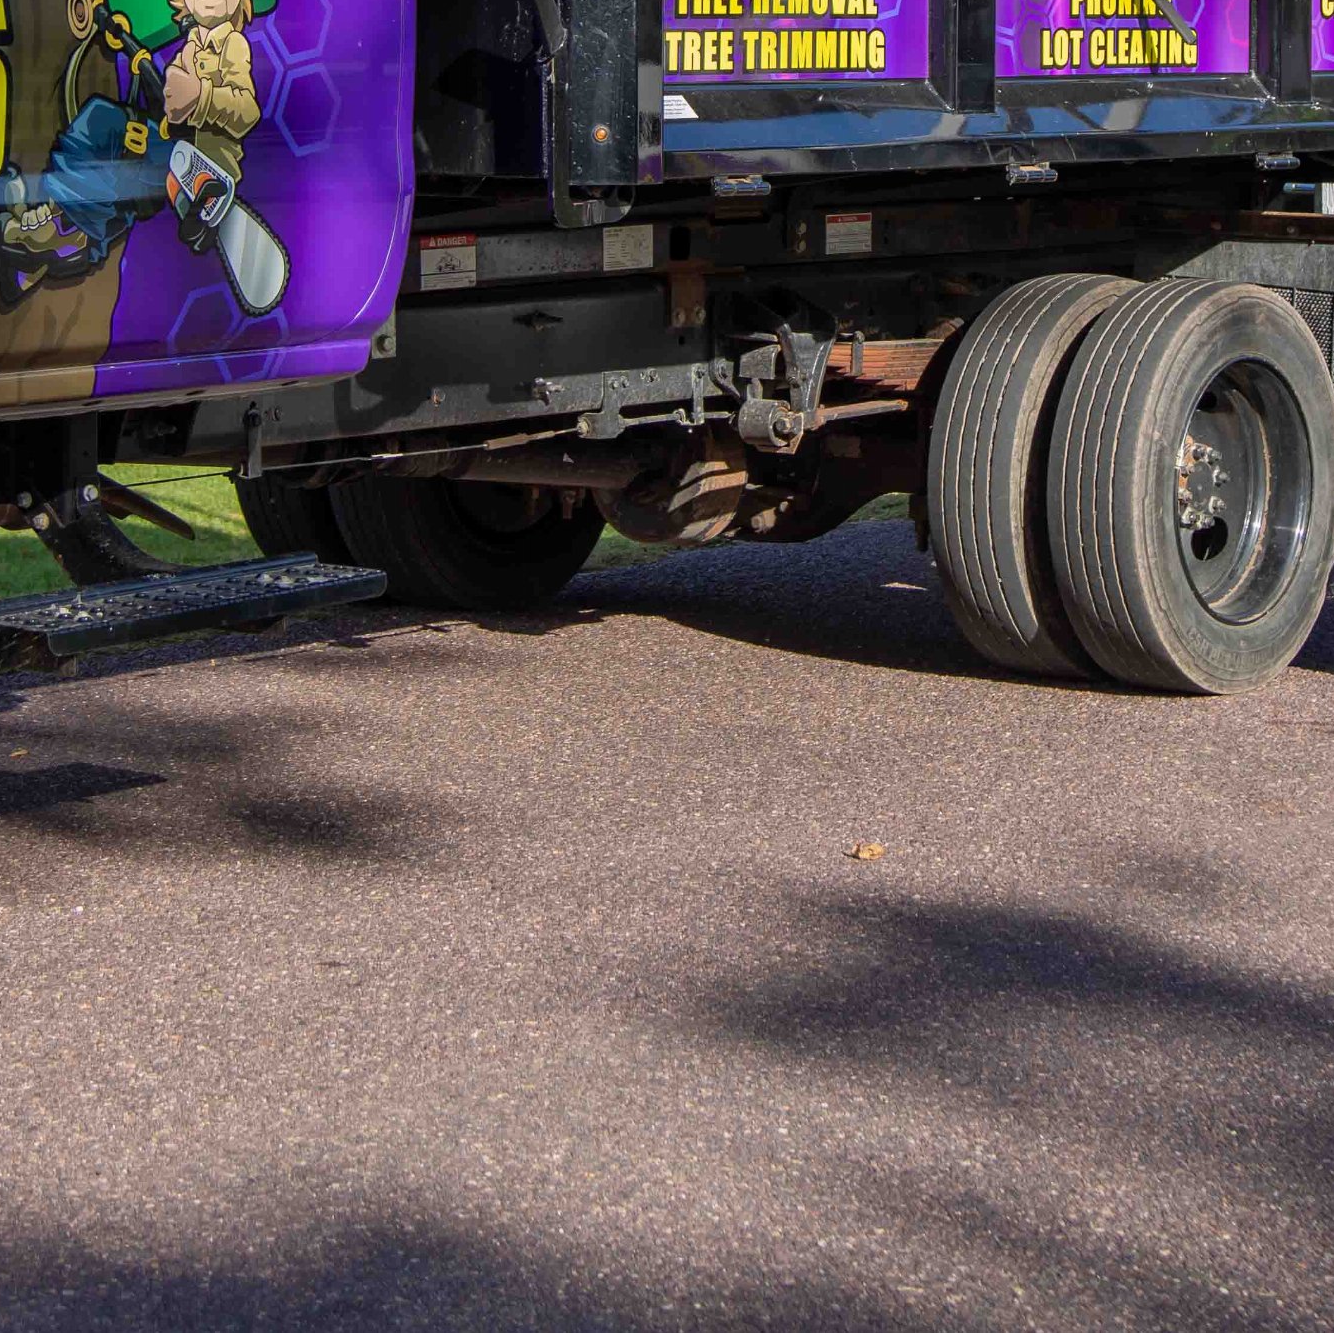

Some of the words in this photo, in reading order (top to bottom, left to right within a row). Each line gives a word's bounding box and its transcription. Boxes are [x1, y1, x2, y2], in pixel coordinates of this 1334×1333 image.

[665, 30, 734, 71] TREE
[743, 29, 886, 70] TRIMMING
[1041, 29, 1084, 66] LOT
[1089, 29, 1198, 66] CLEARING
[437, 236, 467, 246] DANGER
